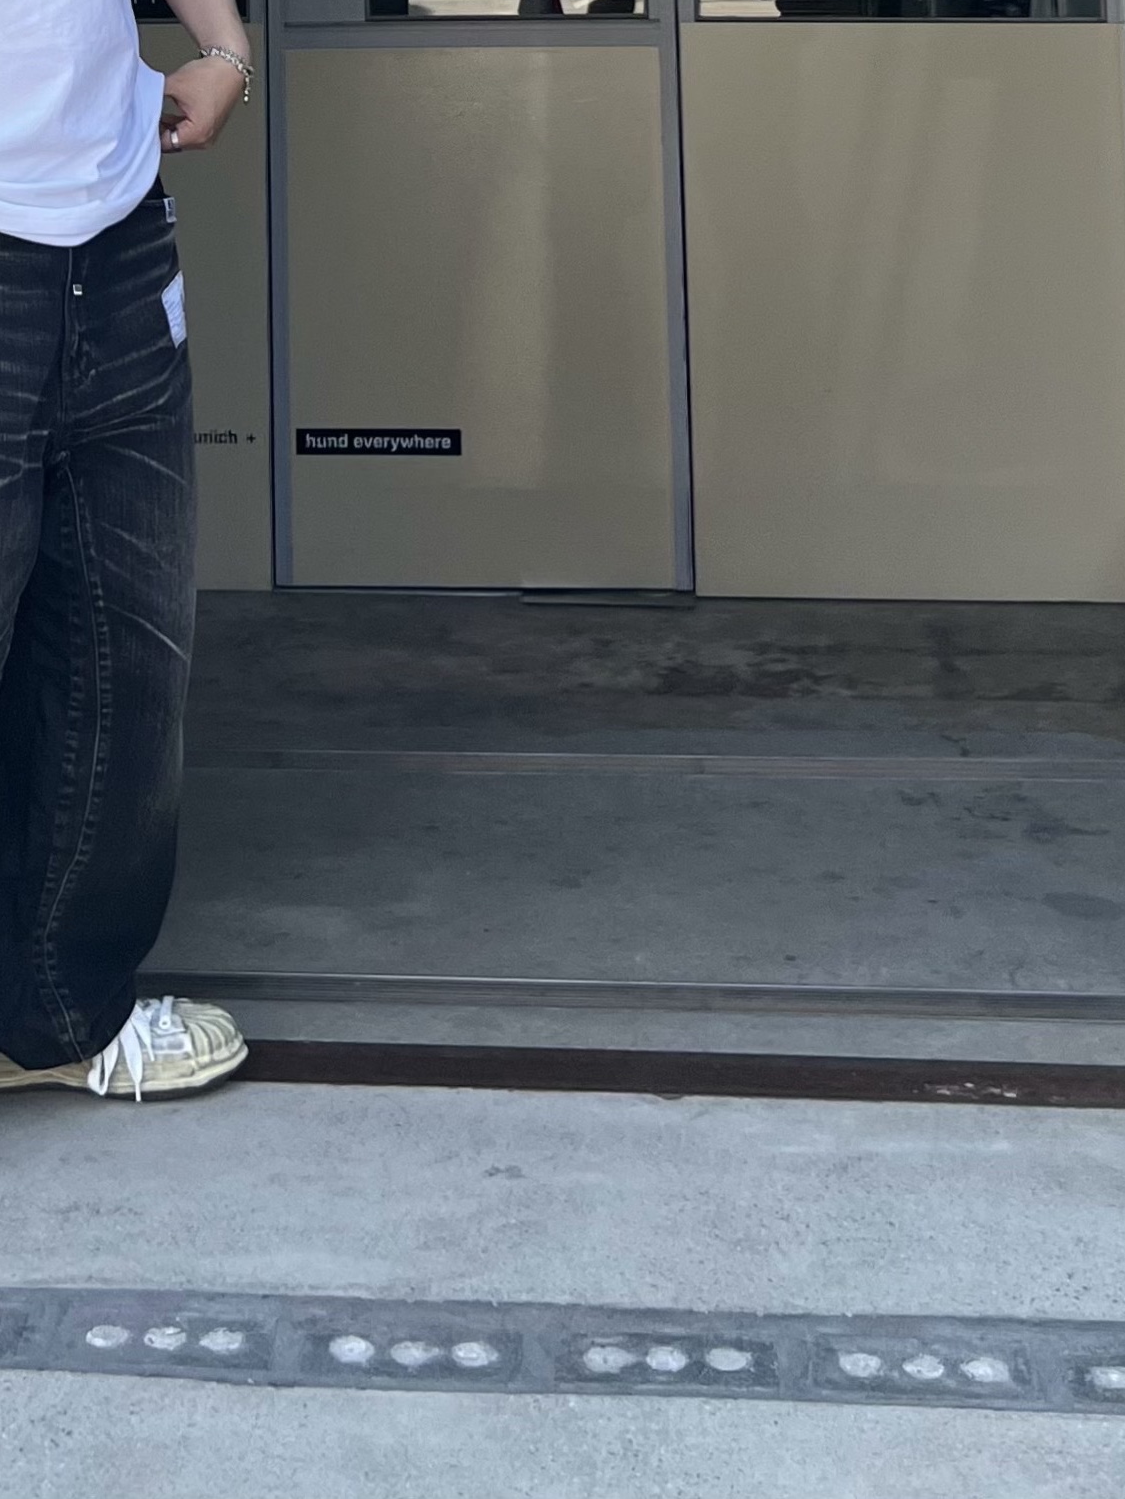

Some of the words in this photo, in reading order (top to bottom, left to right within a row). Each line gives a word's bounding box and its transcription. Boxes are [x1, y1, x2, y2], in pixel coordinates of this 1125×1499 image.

[193, 429, 238, 444] unich
[305, 433, 349, 448] hund
[353, 434, 452, 452] everywhere
